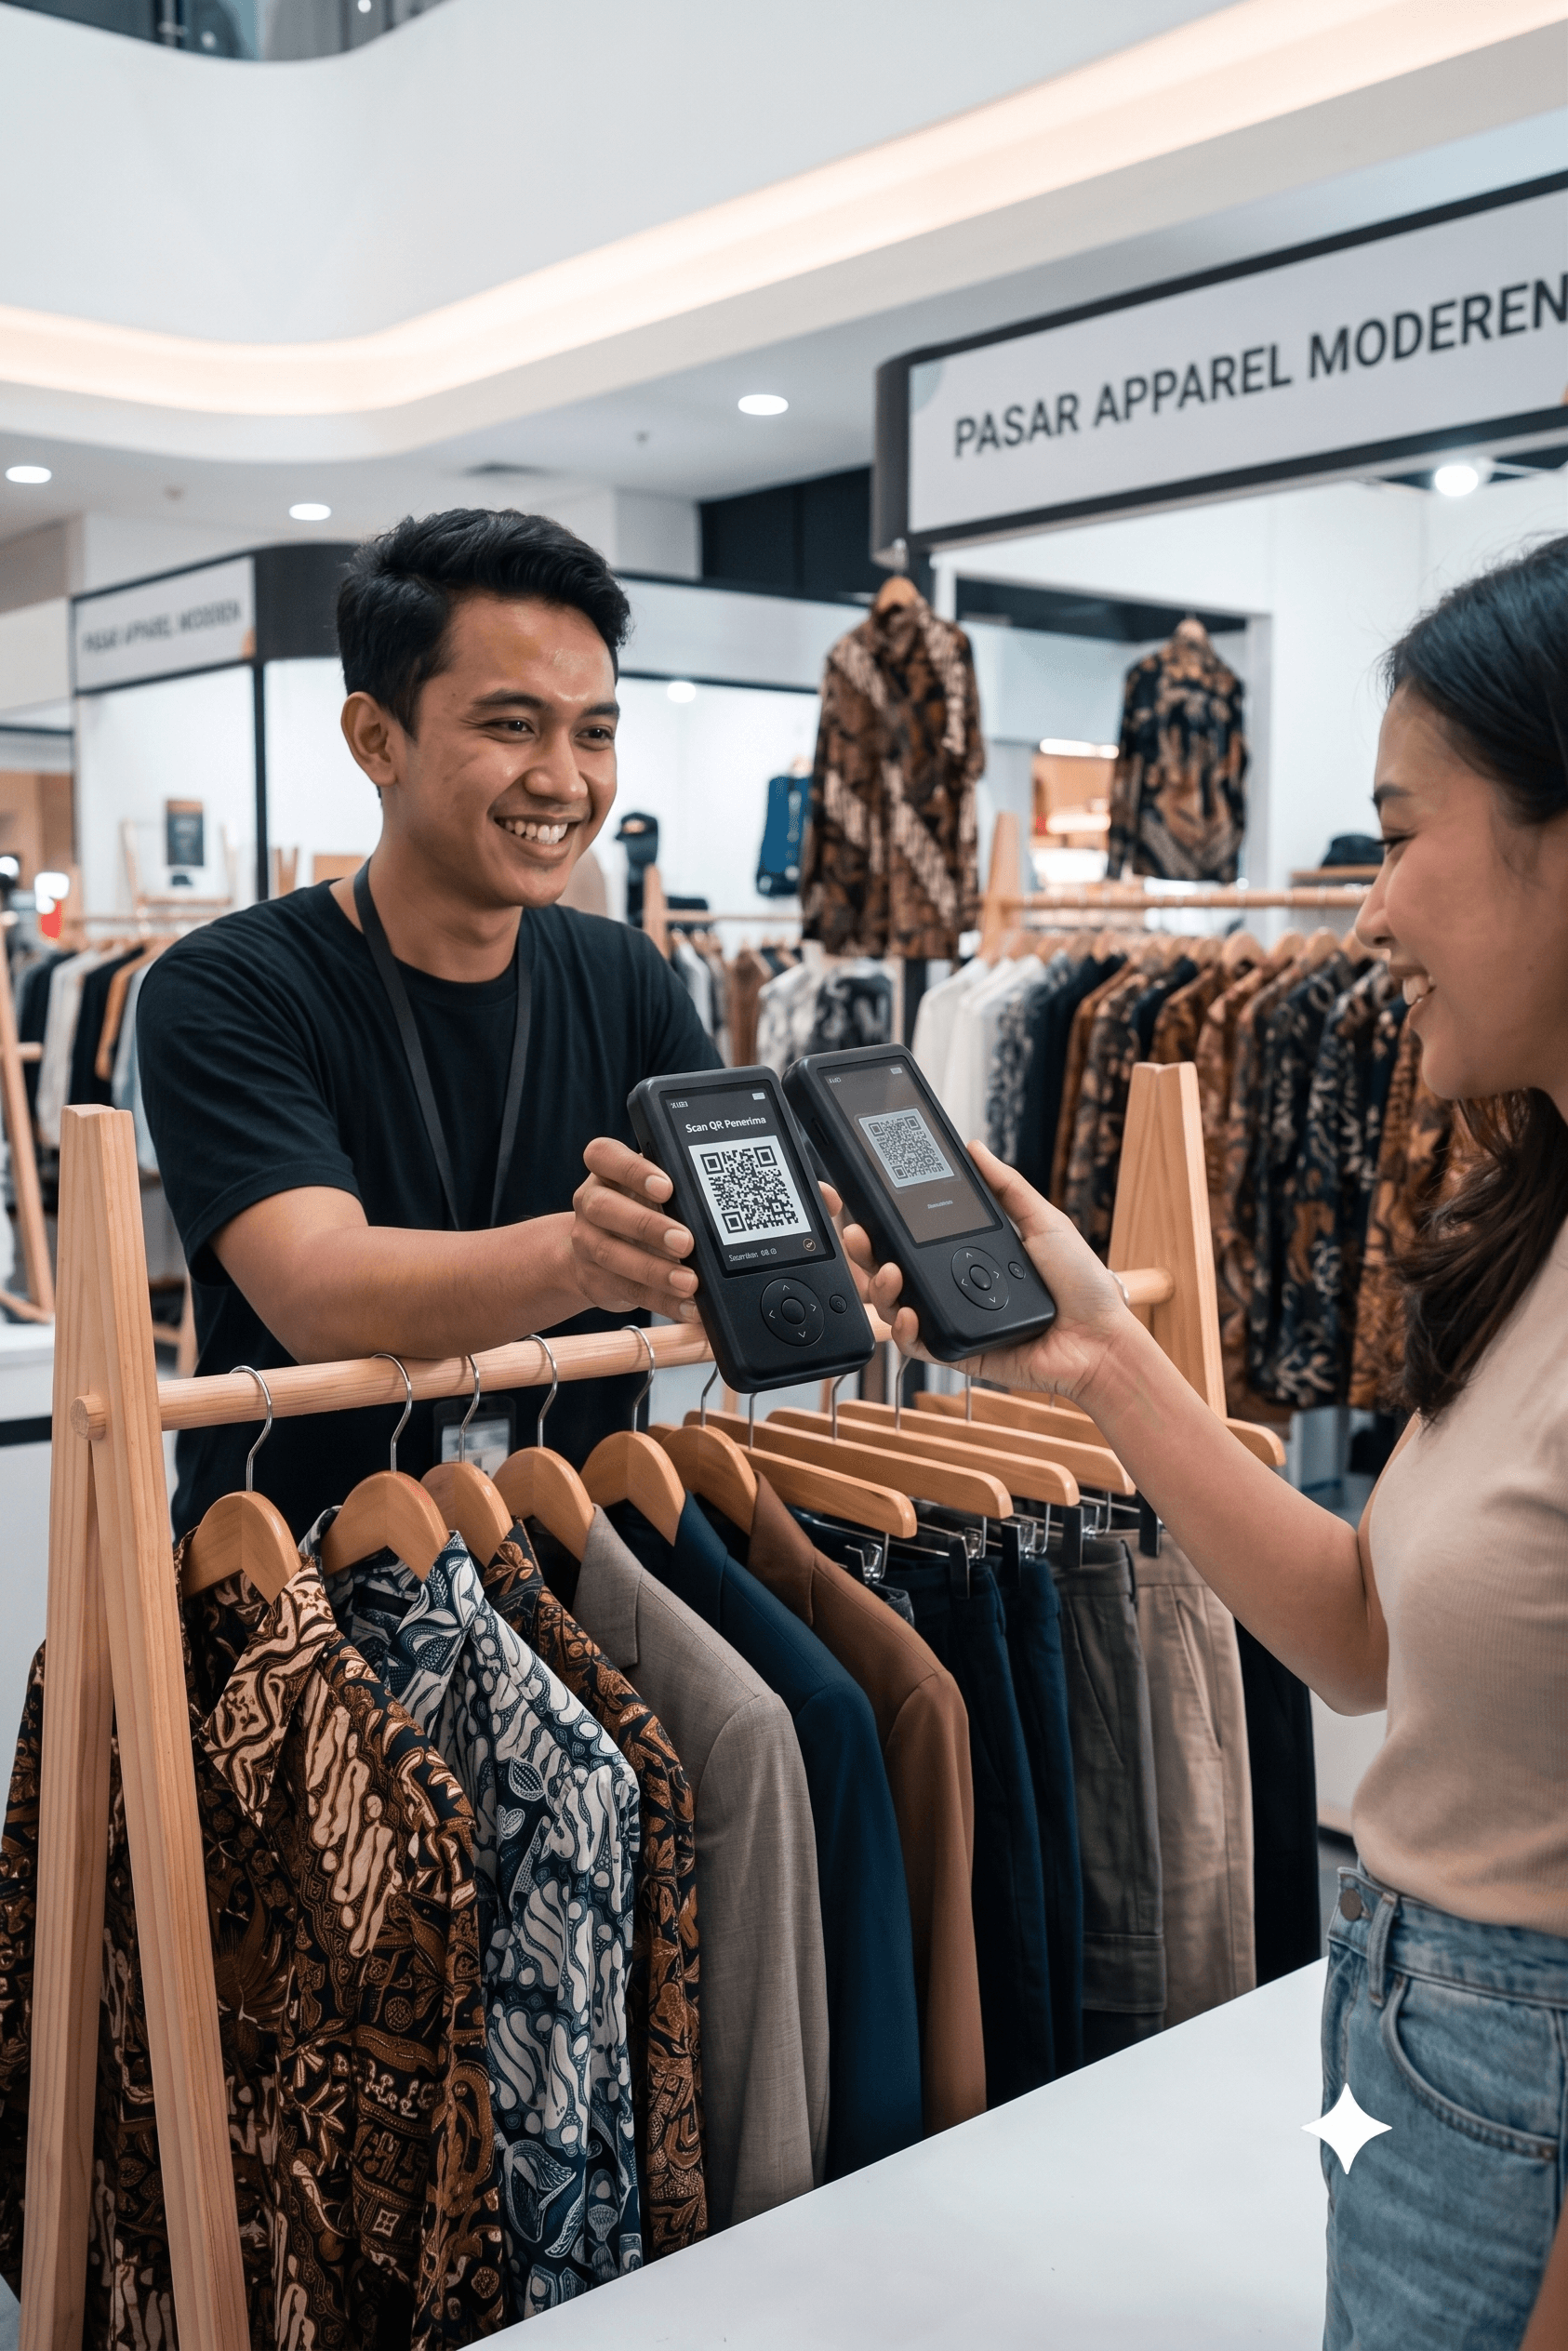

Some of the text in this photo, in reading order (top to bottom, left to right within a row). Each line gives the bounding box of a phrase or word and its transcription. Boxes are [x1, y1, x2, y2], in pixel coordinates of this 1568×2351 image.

[954, 272, 1568, 458] PASAR APPAREL MODEREN
[685, 1116, 766, 1133] Scan QR Penerima
